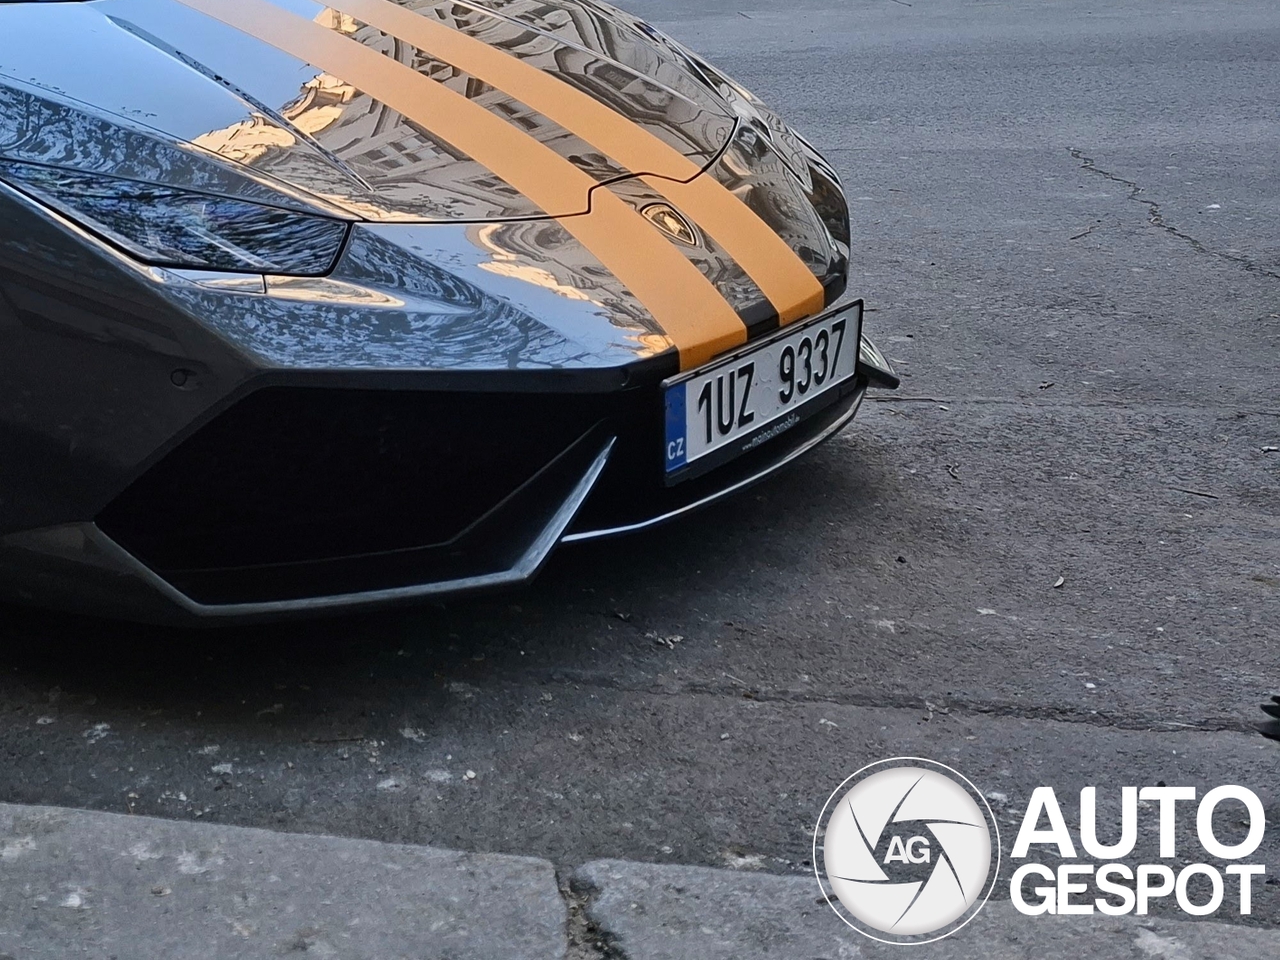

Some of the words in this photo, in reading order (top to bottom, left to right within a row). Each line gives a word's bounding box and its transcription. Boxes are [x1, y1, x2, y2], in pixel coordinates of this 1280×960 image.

[698, 361, 756, 444] 1UZ
[778, 318, 847, 404] 9337
[667, 437, 685, 461] CZ
